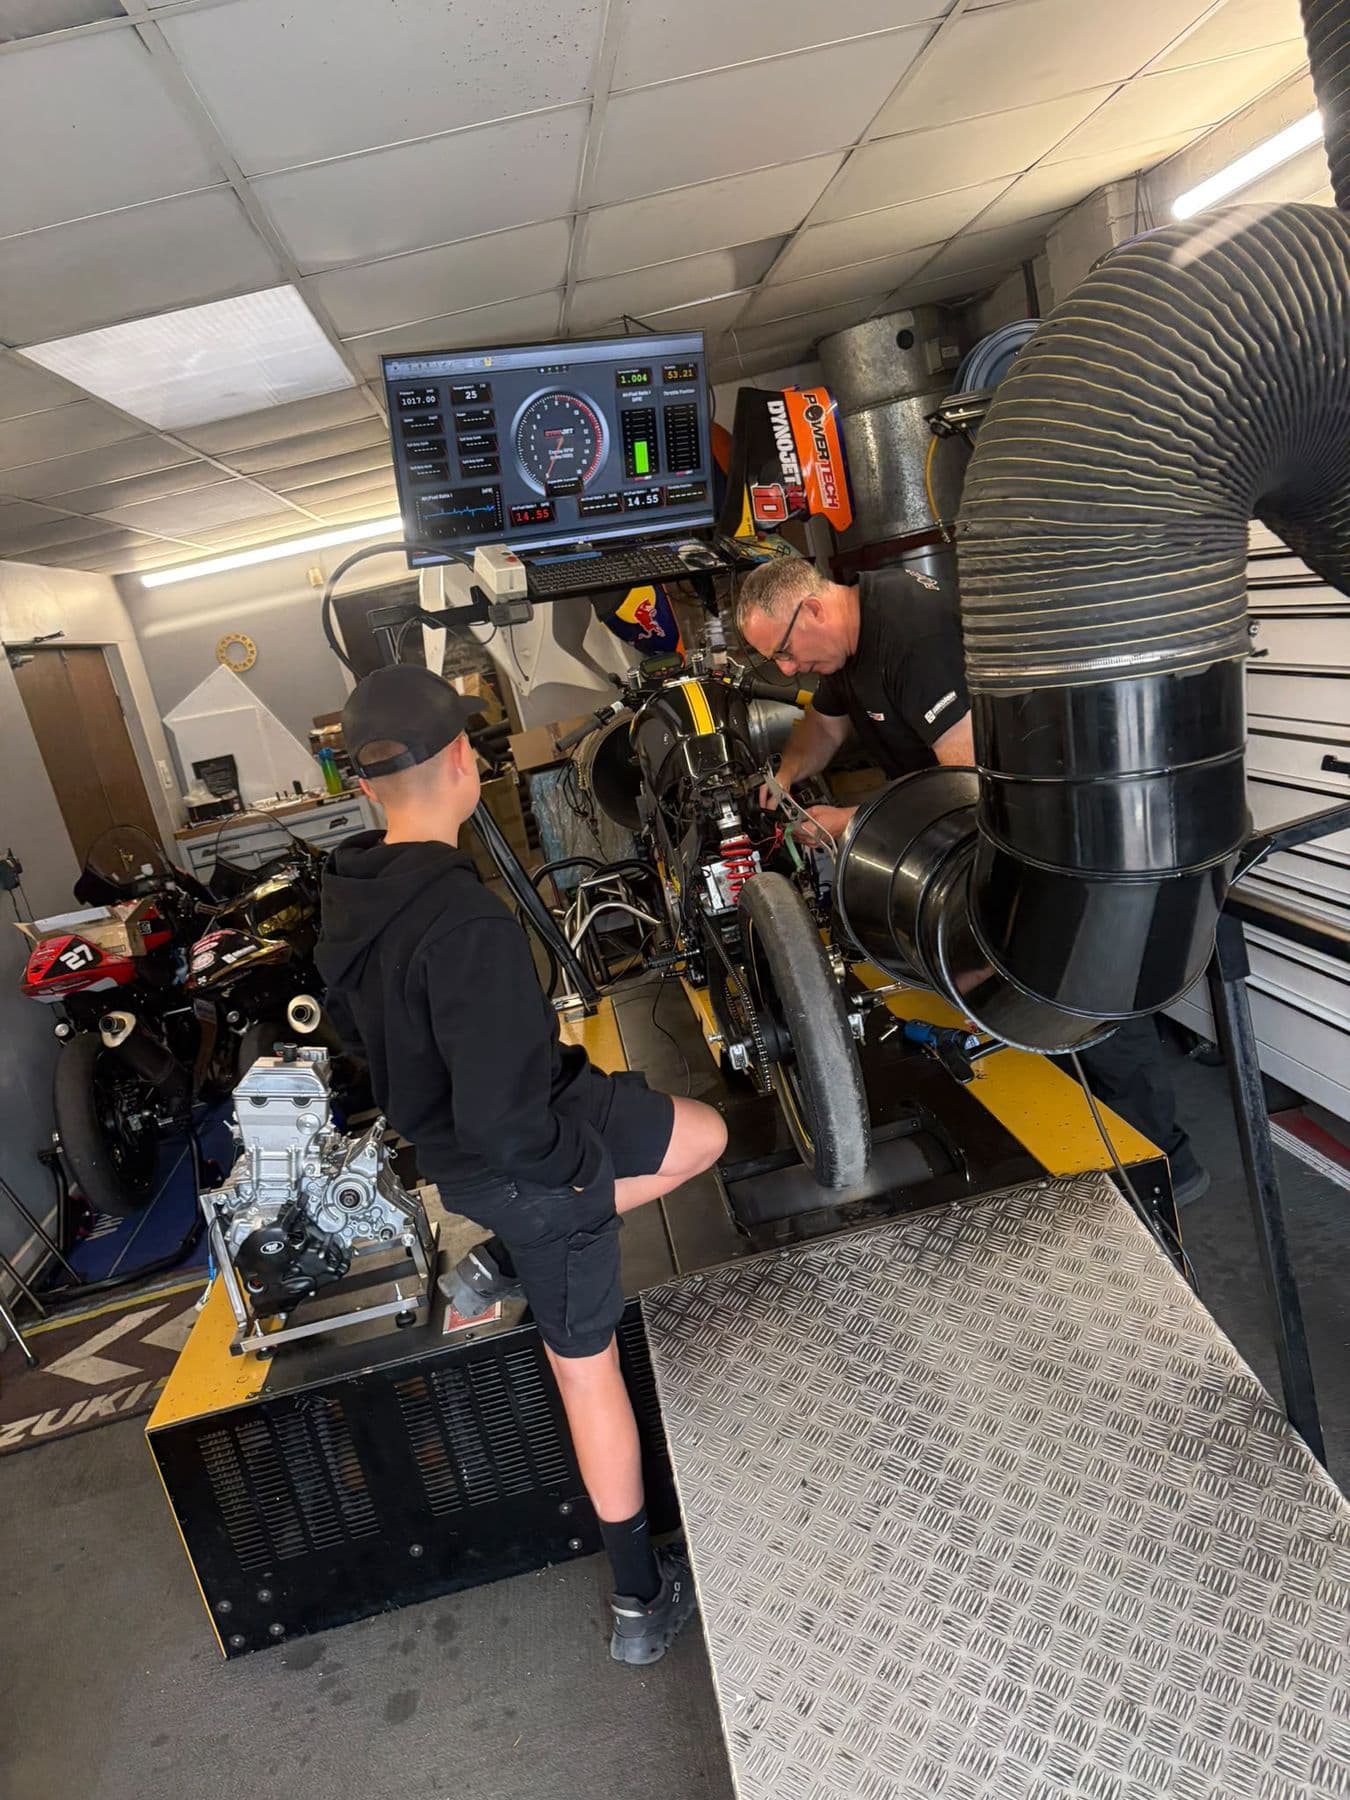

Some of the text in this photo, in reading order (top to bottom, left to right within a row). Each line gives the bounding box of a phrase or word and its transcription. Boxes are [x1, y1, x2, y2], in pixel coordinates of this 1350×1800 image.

[667, 369, 694, 380] 53.21
[465, 390, 478, 400] 25
[627, 494, 659, 507] 14.55
[515, 510, 550, 523] 14.55
[59, 943, 94, 971] 27
